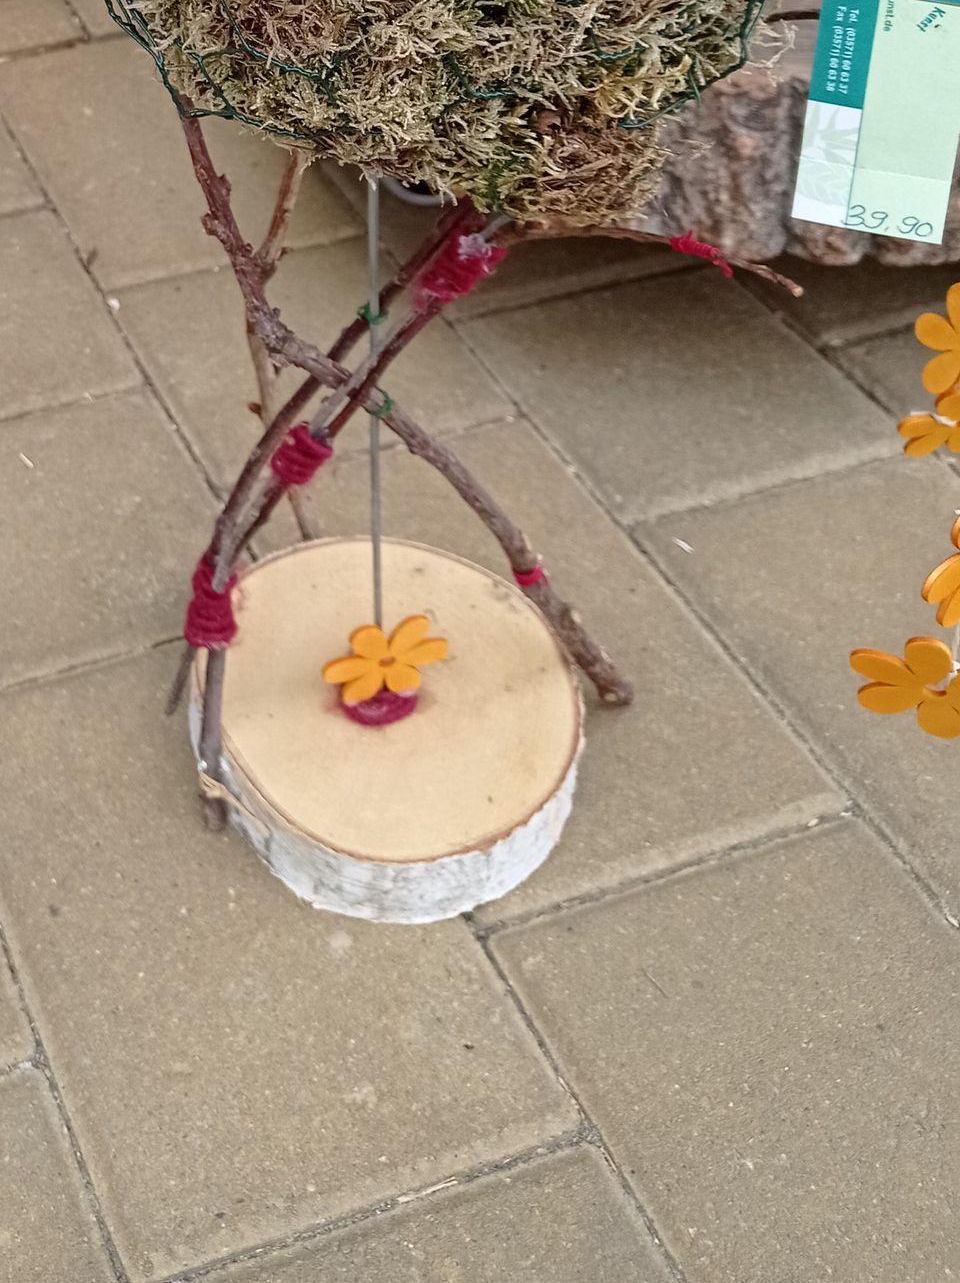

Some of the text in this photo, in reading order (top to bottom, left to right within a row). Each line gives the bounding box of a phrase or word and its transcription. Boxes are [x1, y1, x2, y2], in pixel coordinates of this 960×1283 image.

[835, 6, 847, 21] Fax
[848, 9, 859, 23] Tel.
[917, 7, 946, 32] Kunst
[829, 25, 844, 56] (03571)
[842, 27, 856, 58] (03571)
[840, 204, 933, 237] 39,90
